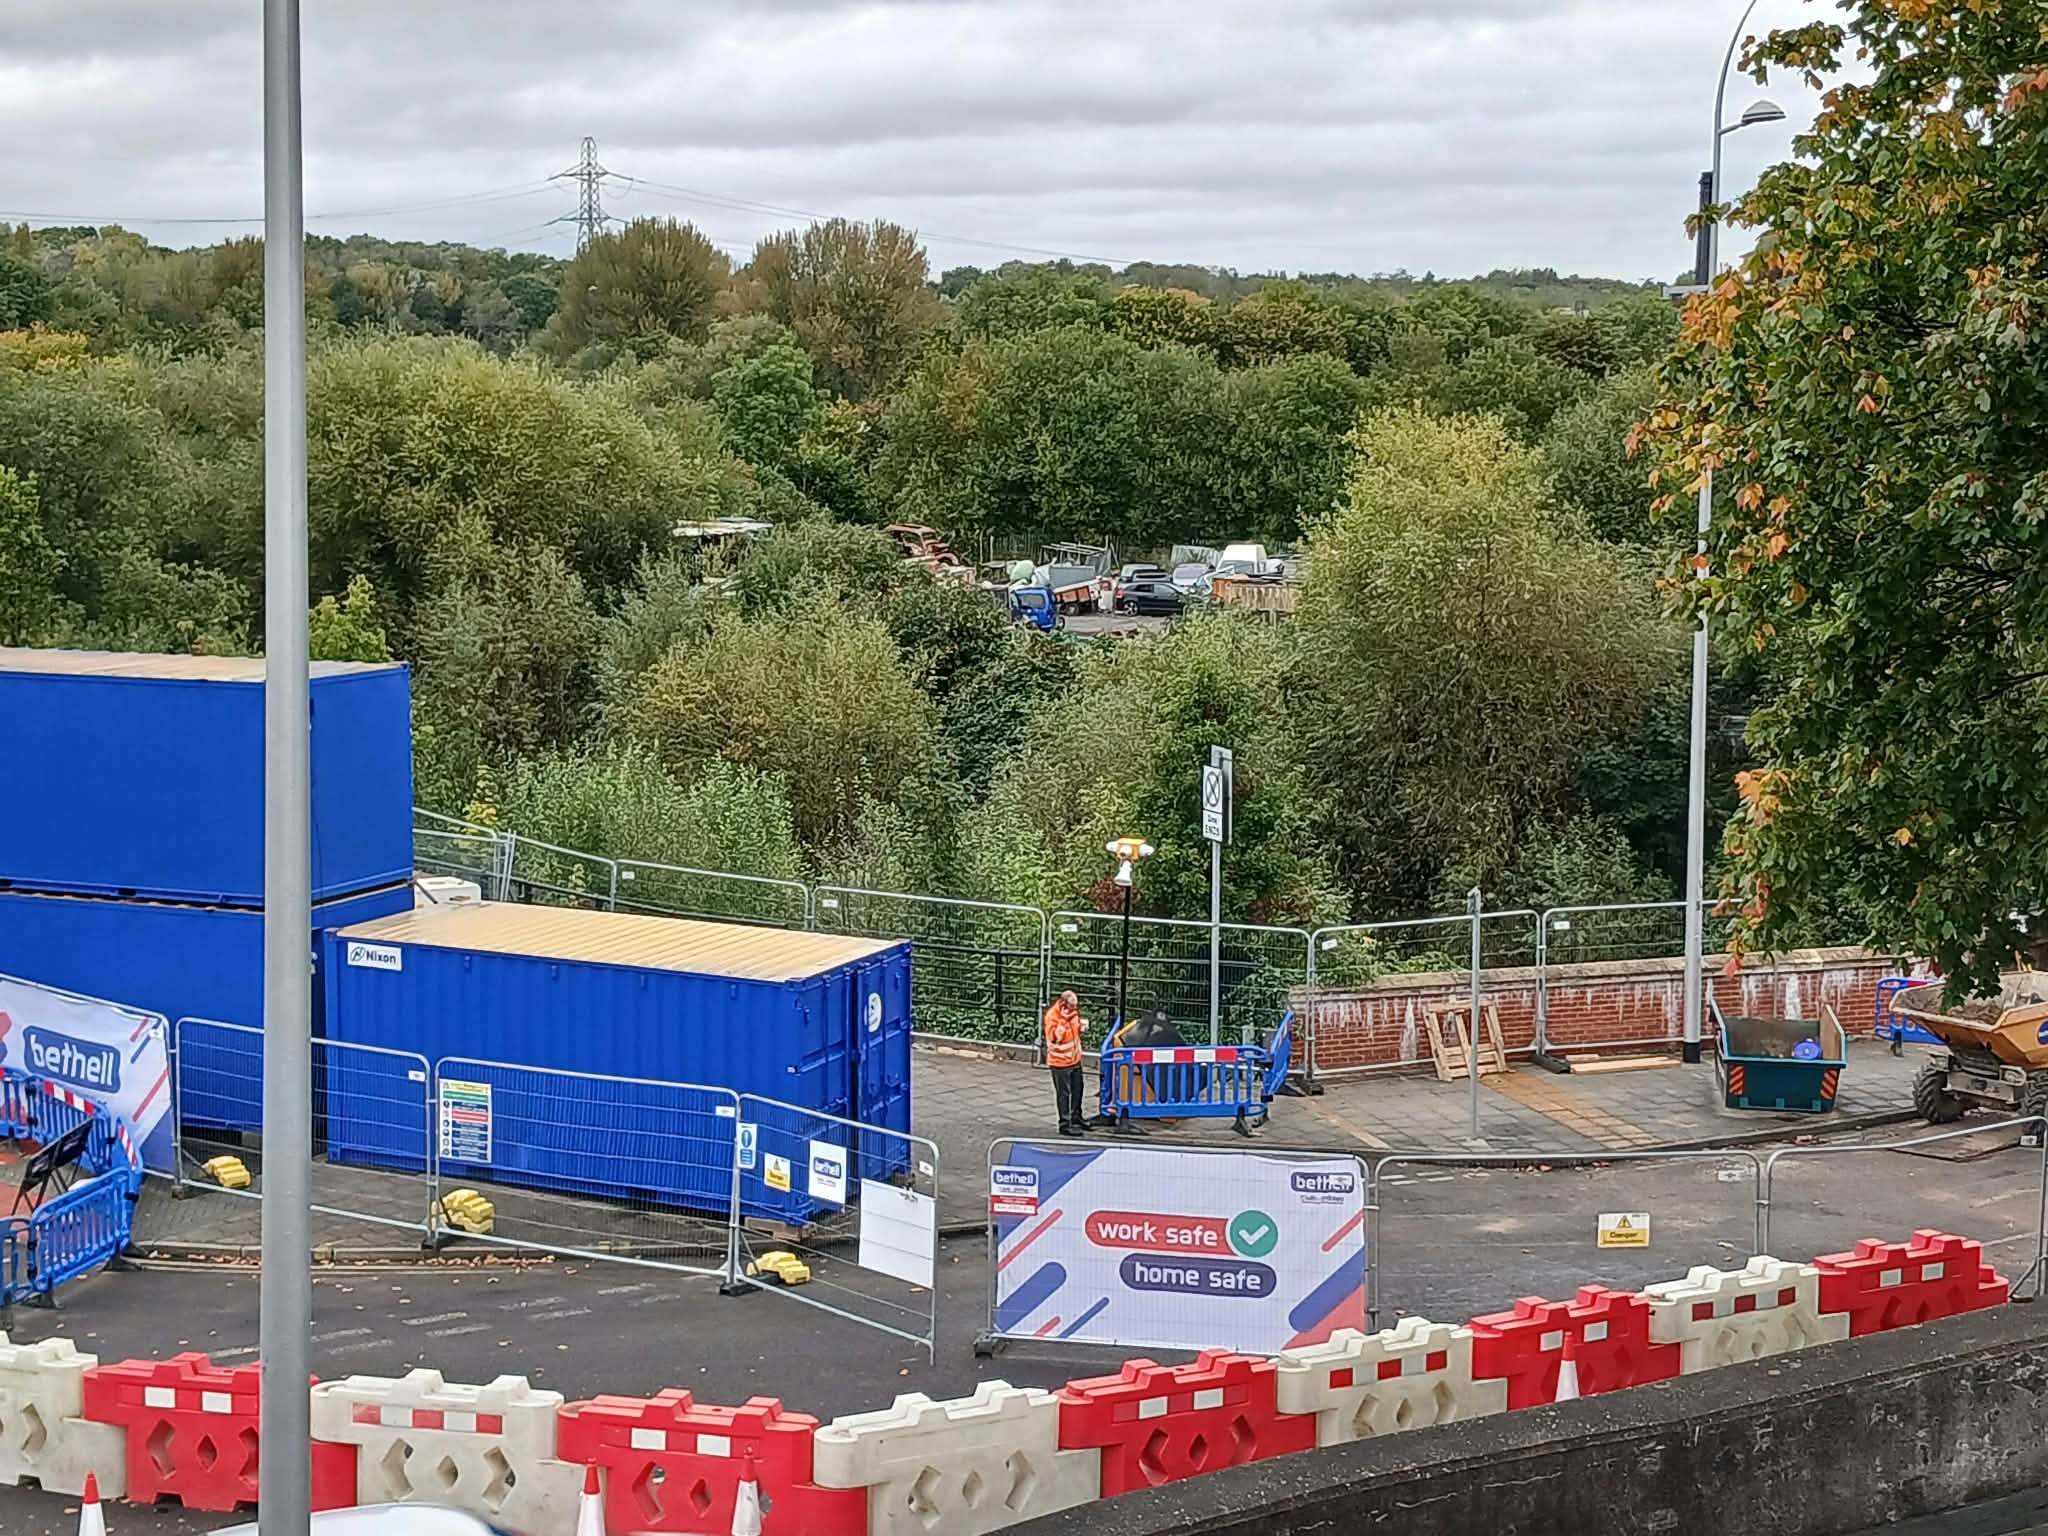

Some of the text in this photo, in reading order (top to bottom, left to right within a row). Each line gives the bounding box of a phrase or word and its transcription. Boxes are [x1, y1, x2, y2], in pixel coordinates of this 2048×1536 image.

[366, 950, 397, 964] Nixon
[30, 1034, 114, 1086] bethell
[995, 1172, 1034, 1185] bethell
[1097, 1221, 1218, 1247] work safe
[1135, 1261, 1261, 1290] home safe
